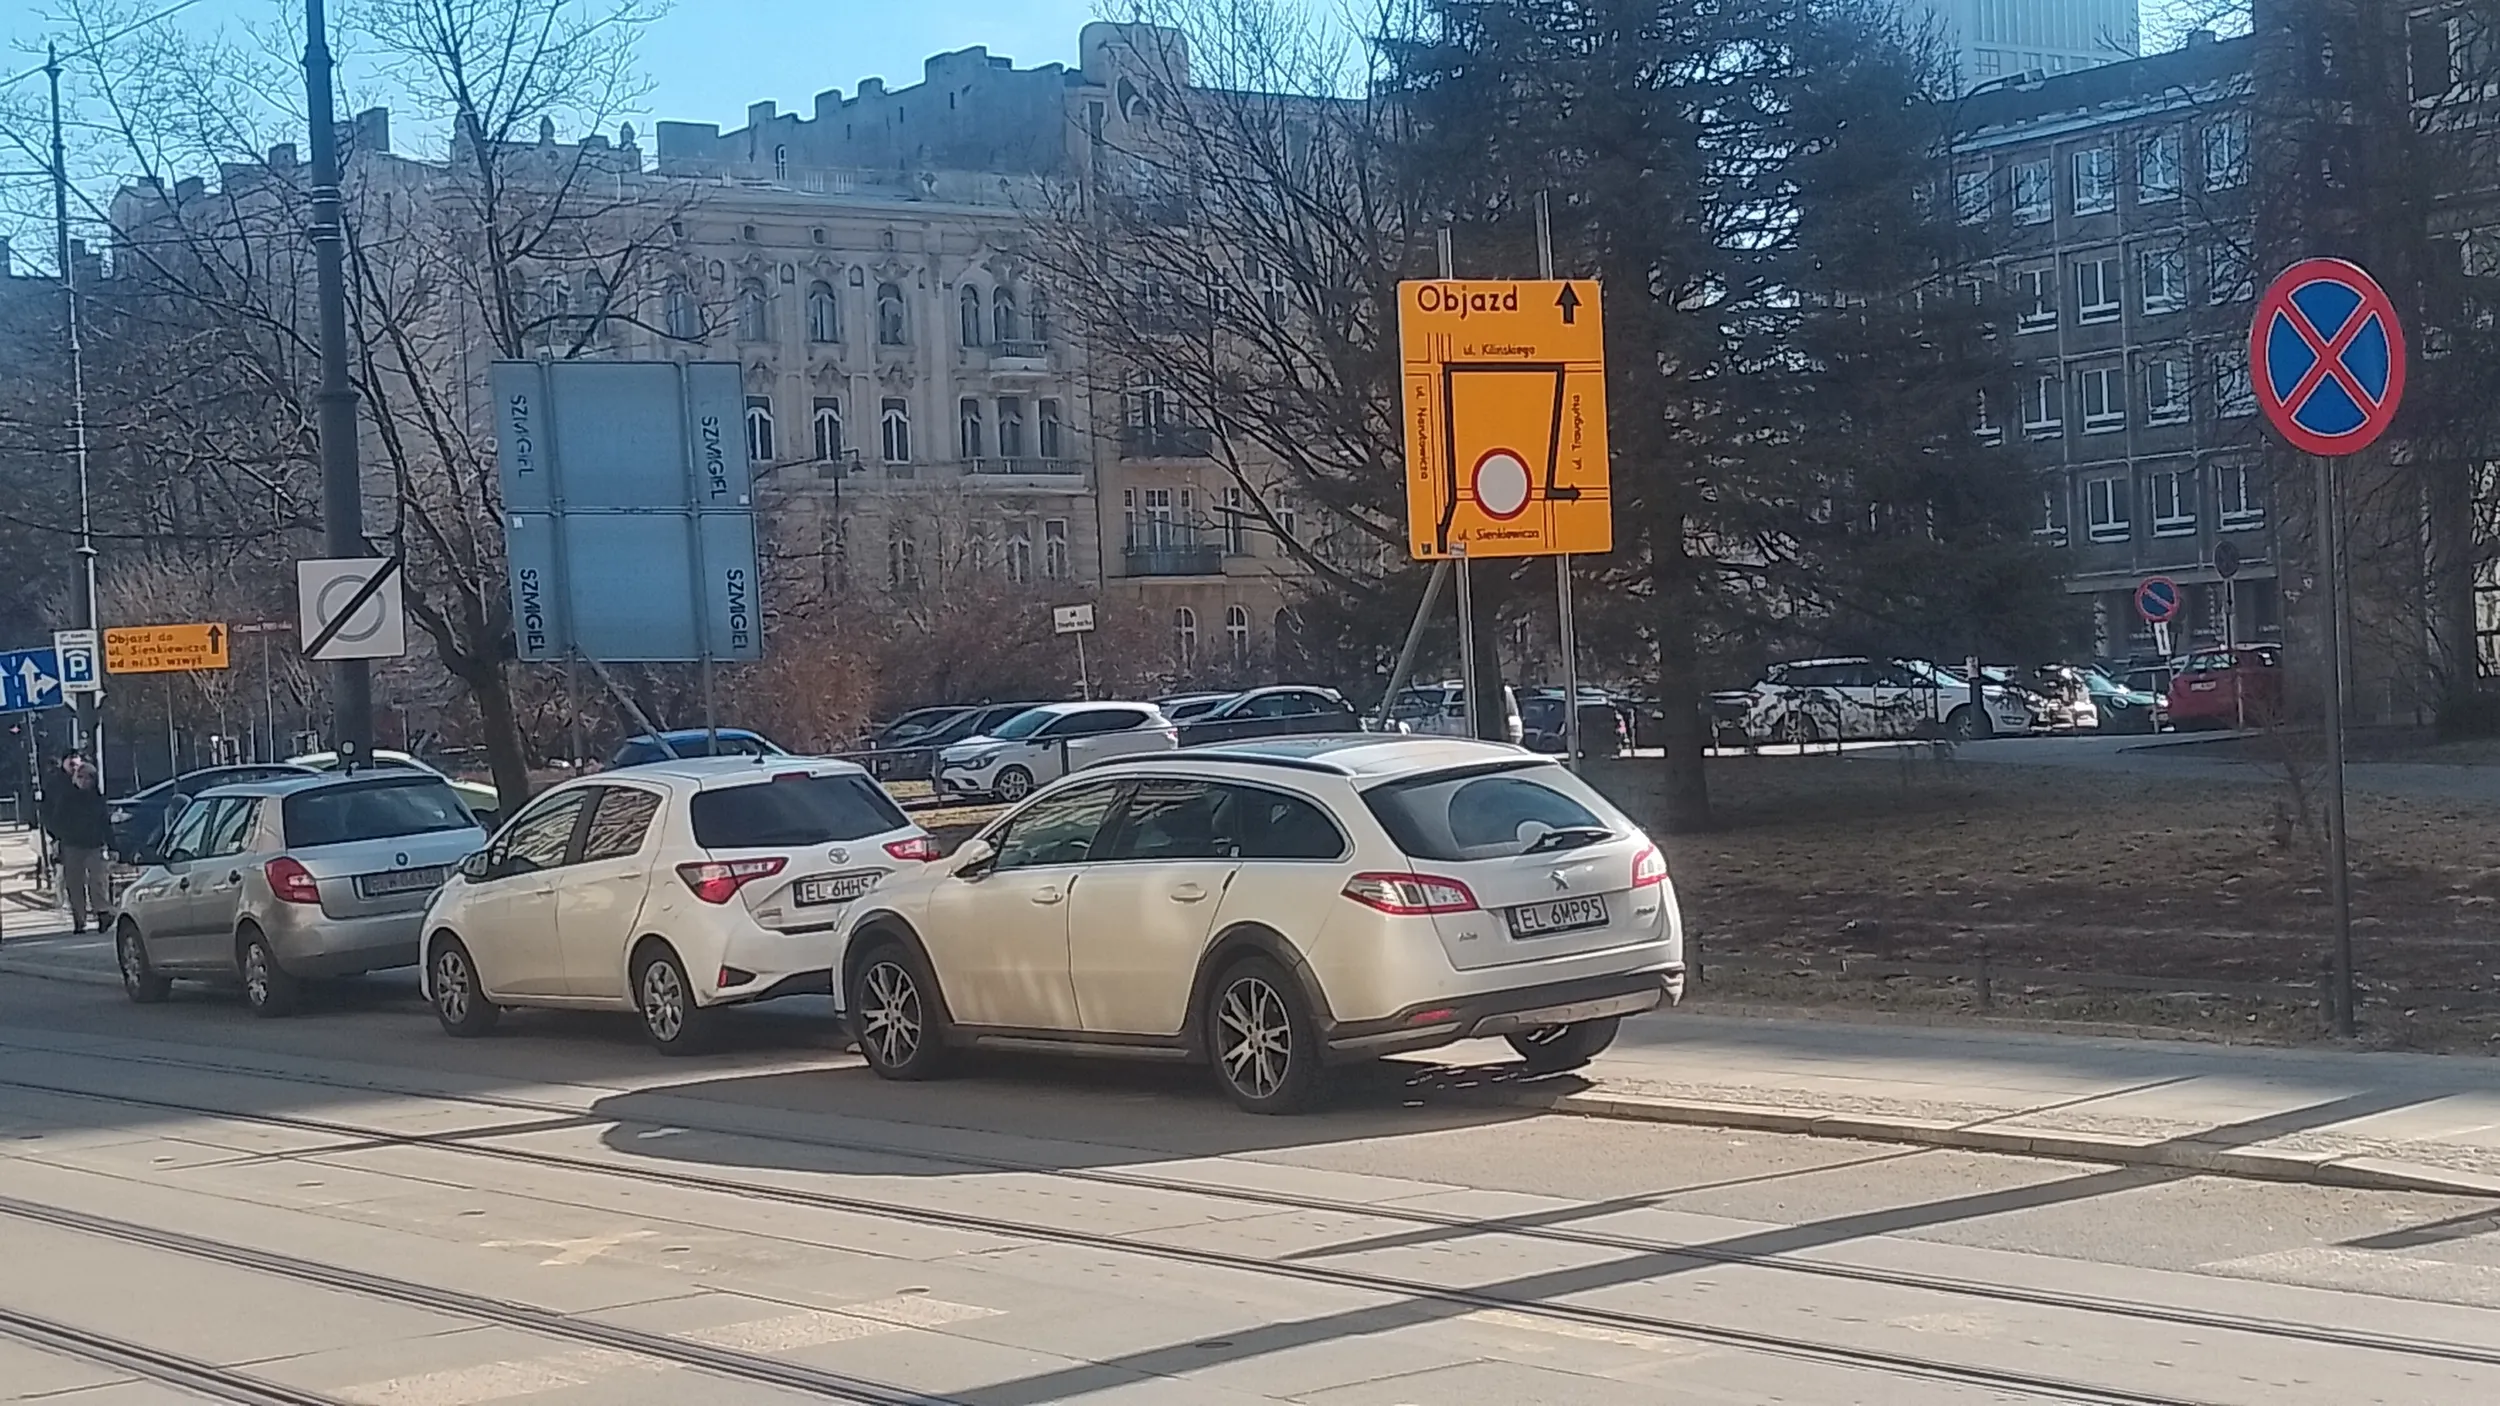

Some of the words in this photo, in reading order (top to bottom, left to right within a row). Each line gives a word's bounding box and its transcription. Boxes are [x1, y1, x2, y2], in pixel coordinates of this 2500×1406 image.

[1417, 284, 1518, 320] Objazd
[520, 568, 545, 654] SZMIGIEL
[727, 568, 749, 653] SZMIGIEL
[108, 632, 151, 645] Objazd
[158, 633, 174, 642] do
[131, 644, 207, 656] Sienkiewicza
[109, 659, 124, 668] od
[806, 883, 826, 900] EL
[1521, 908, 1546, 930] EL
[1550, 898, 1601, 925] 6MP95
